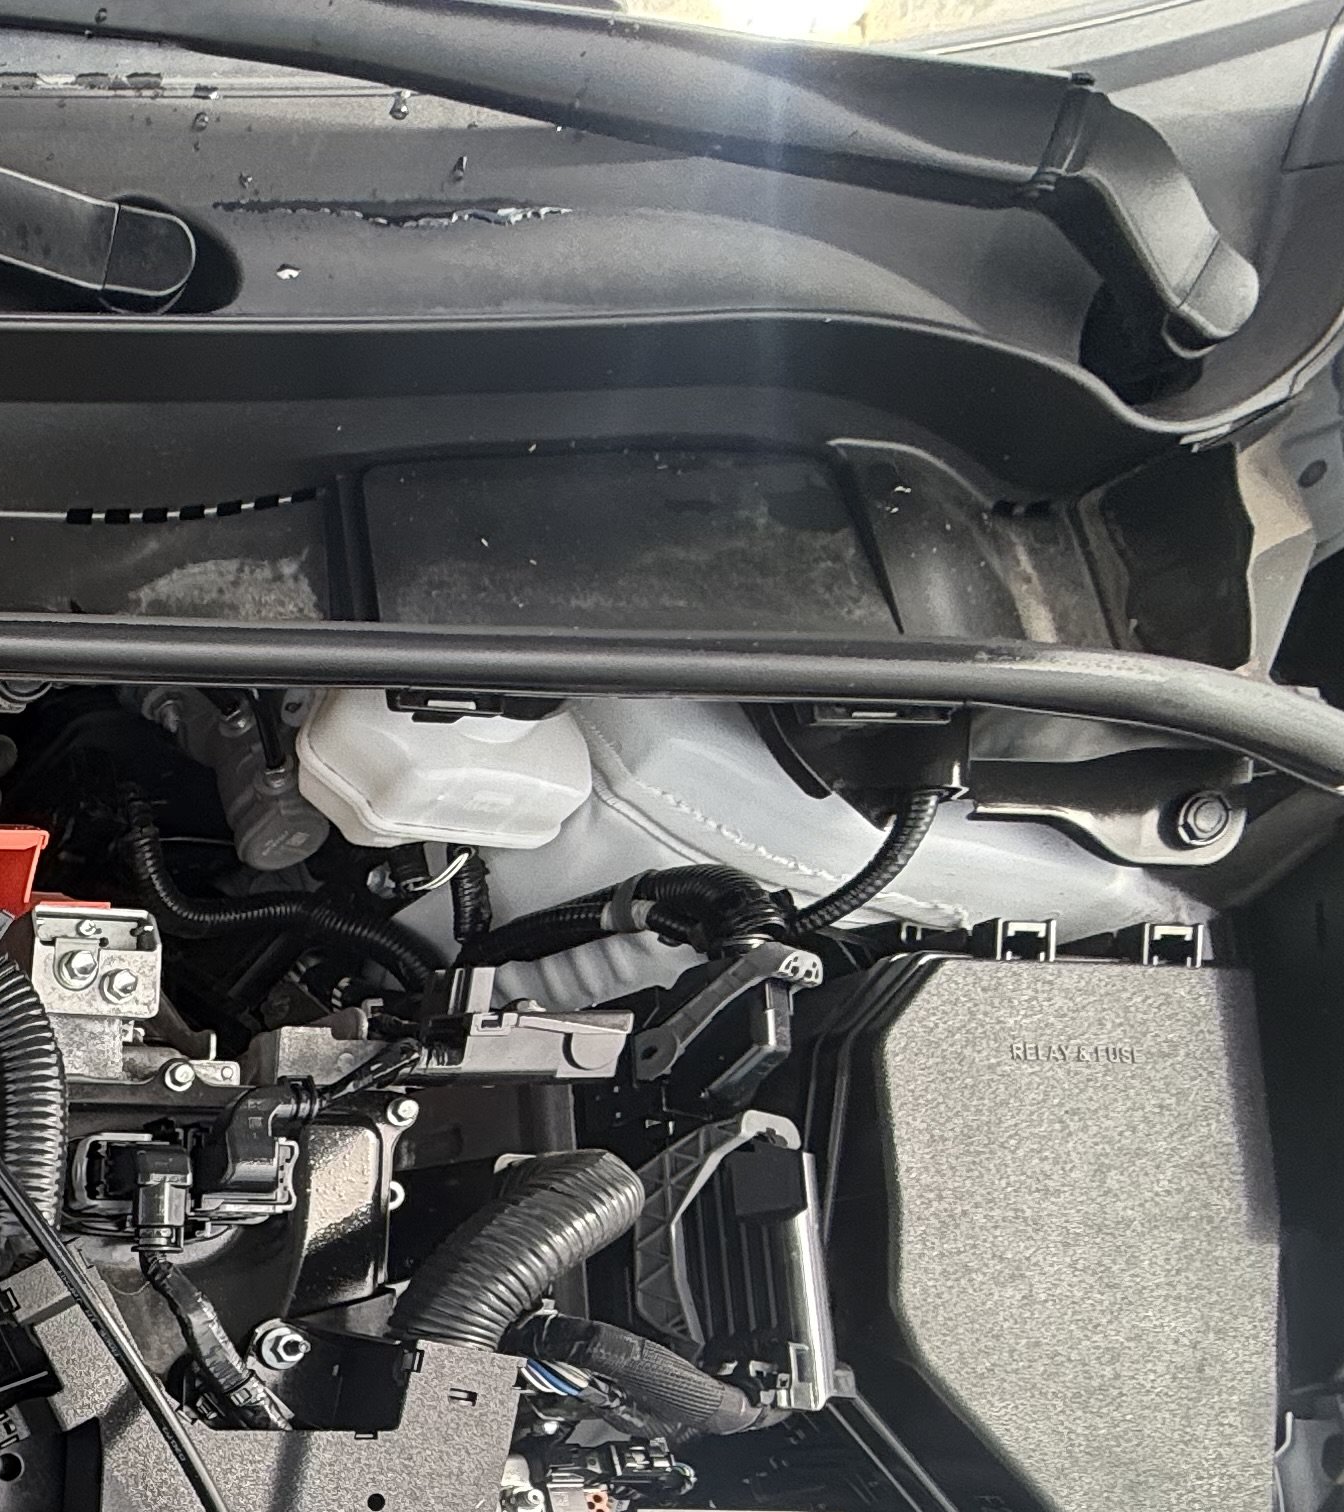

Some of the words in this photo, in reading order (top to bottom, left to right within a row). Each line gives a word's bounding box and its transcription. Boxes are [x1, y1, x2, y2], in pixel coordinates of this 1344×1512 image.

[1010, 1042, 1072, 1062] RELAY
[1077, 1045, 1093, 1063] &
[1096, 1045, 1146, 1064] FUSE
